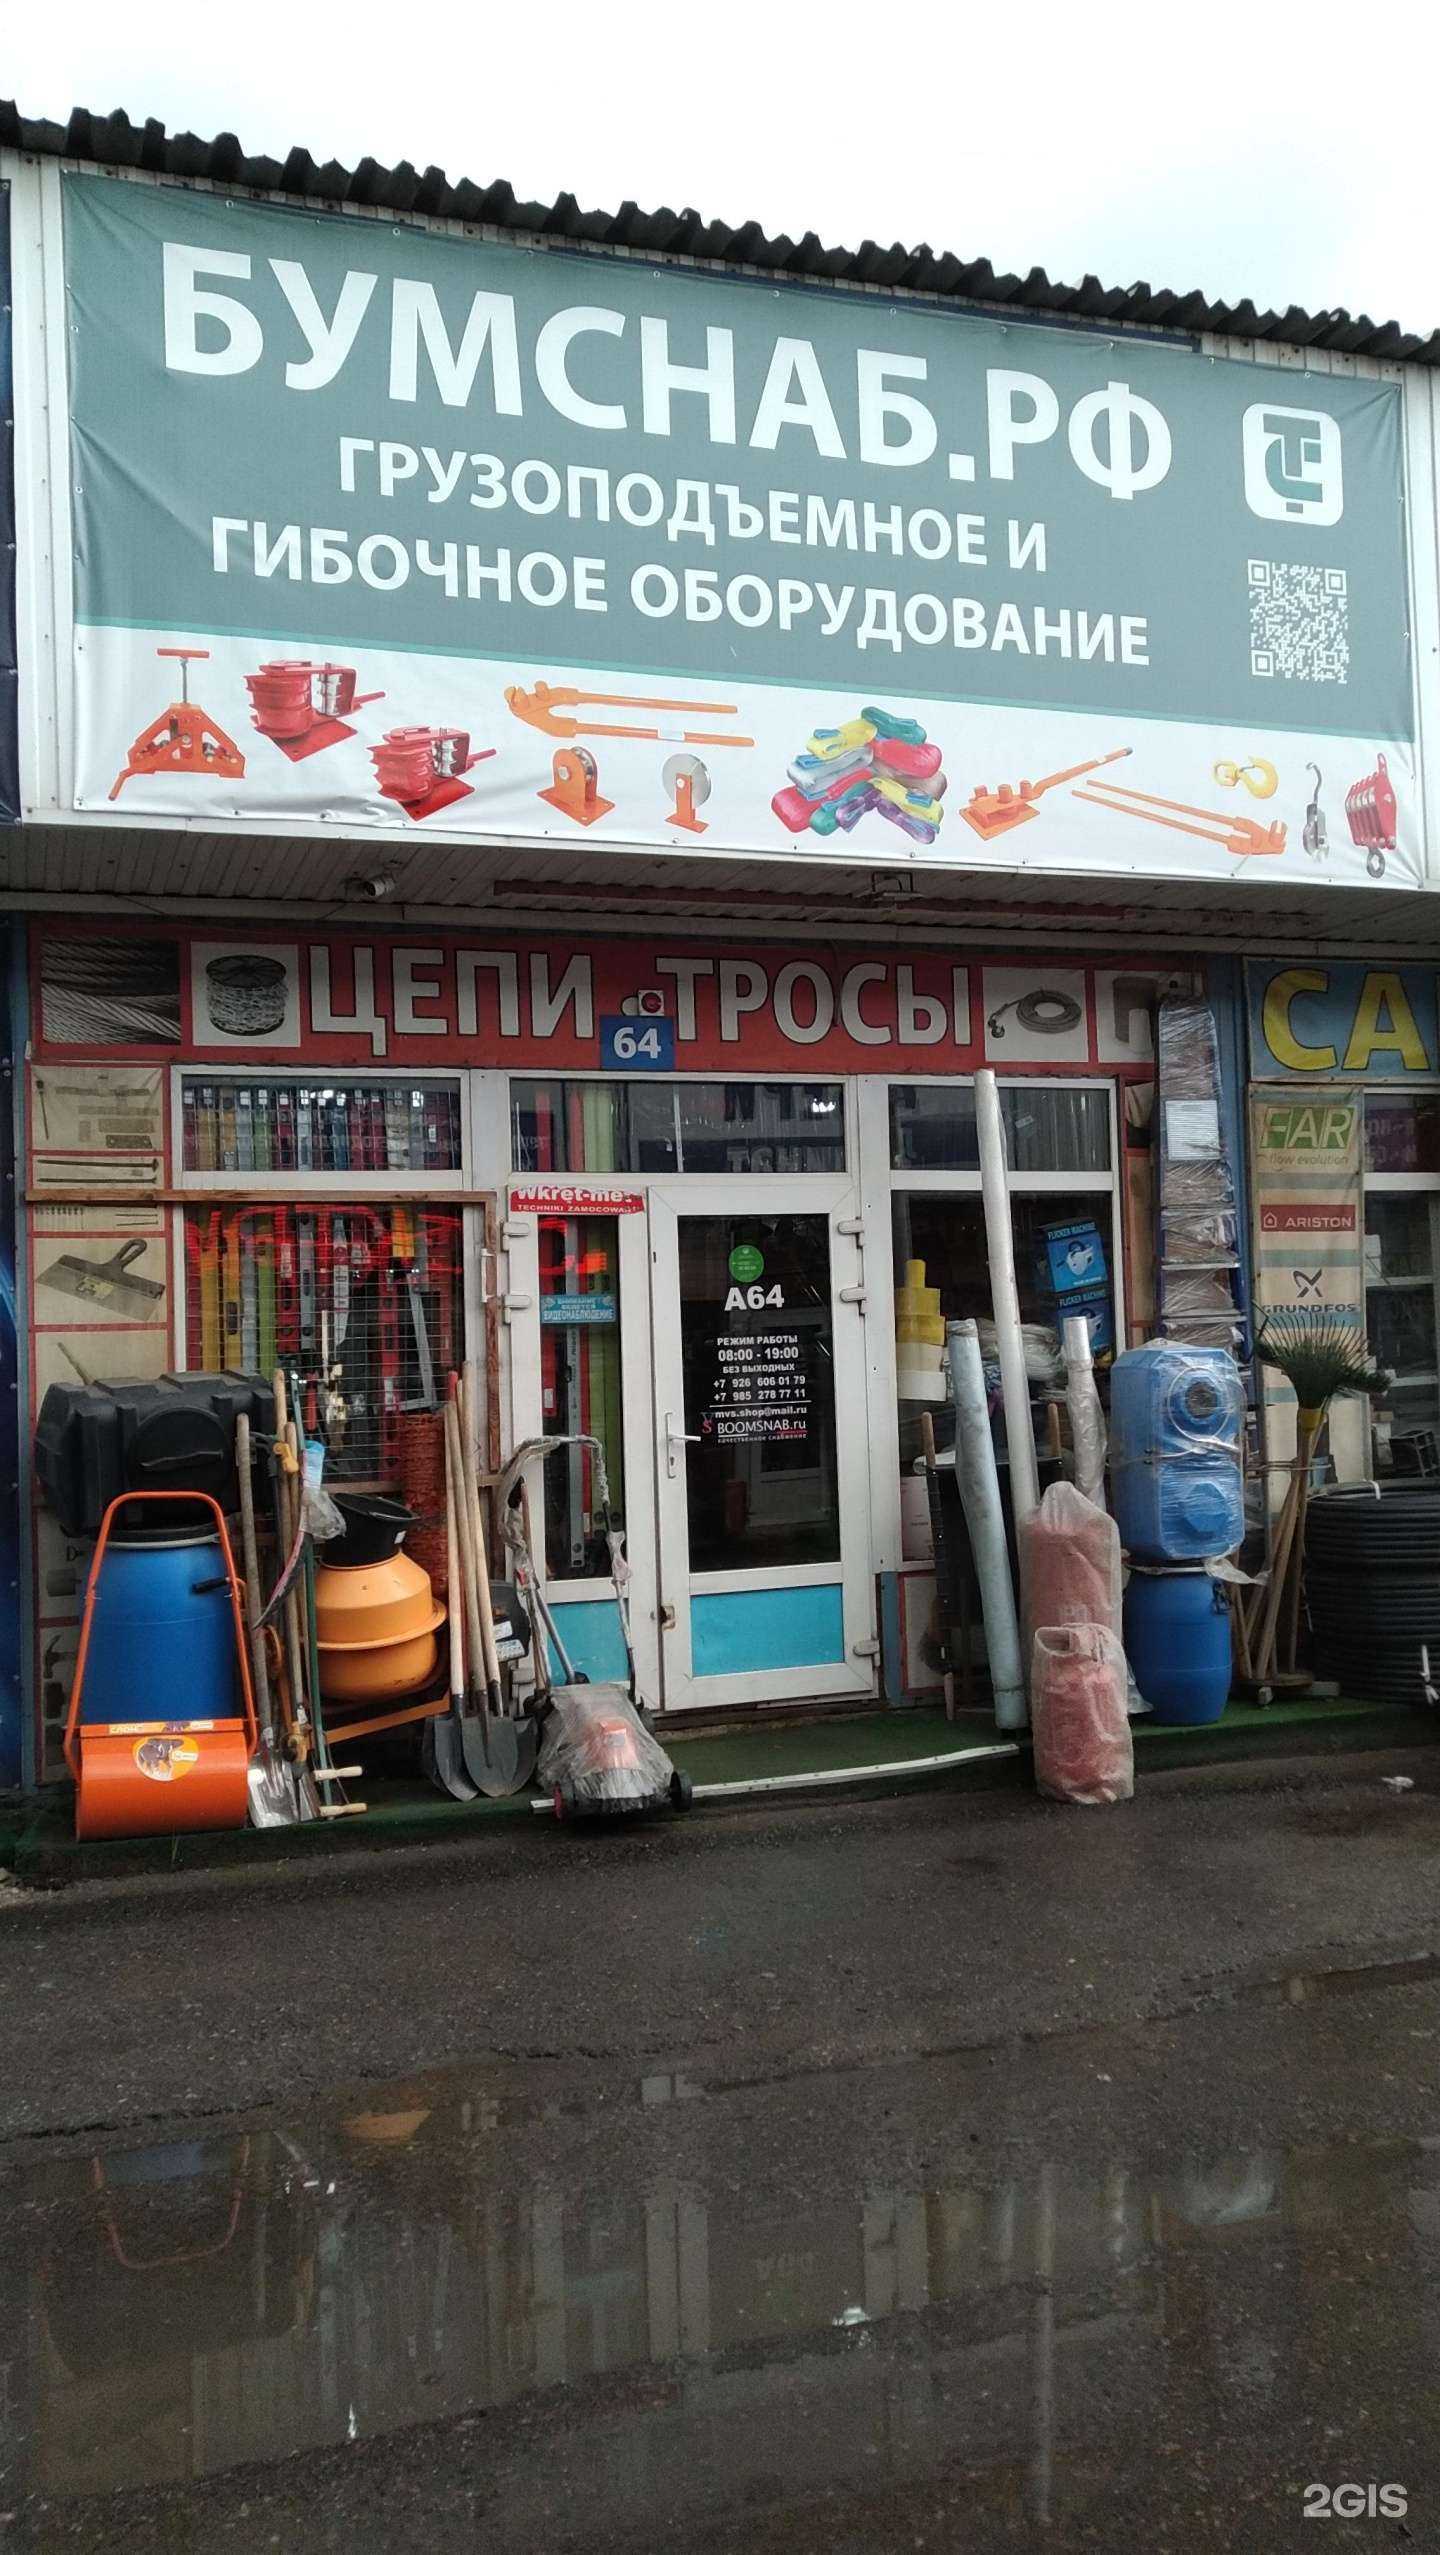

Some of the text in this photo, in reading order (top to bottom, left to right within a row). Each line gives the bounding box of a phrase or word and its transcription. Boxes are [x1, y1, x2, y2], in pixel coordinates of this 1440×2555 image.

[162, 242, 1172, 499] БУМСНАБ.РФ
[339, 437, 1047, 572] ГРУЗОПОДЪЕМНОЕ И
[212, 517, 1150, 665] ГИБОЧНОЕ ОБОРУДОВАНИЕ
[309, 945, 971, 1056] ЦЕПИ ТРОСЫ
[1262, 968, 1440, 1071] СА
[613, 1026, 662, 1059] 64
[1260, 1106, 1352, 1149] FAR
[1297, 1153, 1349, 1165] evolution
[518, 1204, 563, 1212] TECHNIKI
[1285, 1217, 1352, 1228] ARISTON
[717, 1335, 798, 1346] РЕЖИМ РАБОТЫ
[718, 1348, 753, 1362] 08:00
[764, 1347, 799, 1361] 19:00
[723, 1363, 795, 1374] БЕЗ ВЫХОДНЫХ
[713, 1379, 726, 1389] +7
[732, 1378, 751, 1388] 926
[778, 1376, 790, 1386] 01
[793, 1375, 806, 1385] 79
[714, 1388, 806, 1402] +7 985 278 77 11
[715, 1406, 808, 1420] mvs.shop@mail.ru
[717, 1419, 806, 1434] BOOMSNAB.ru
